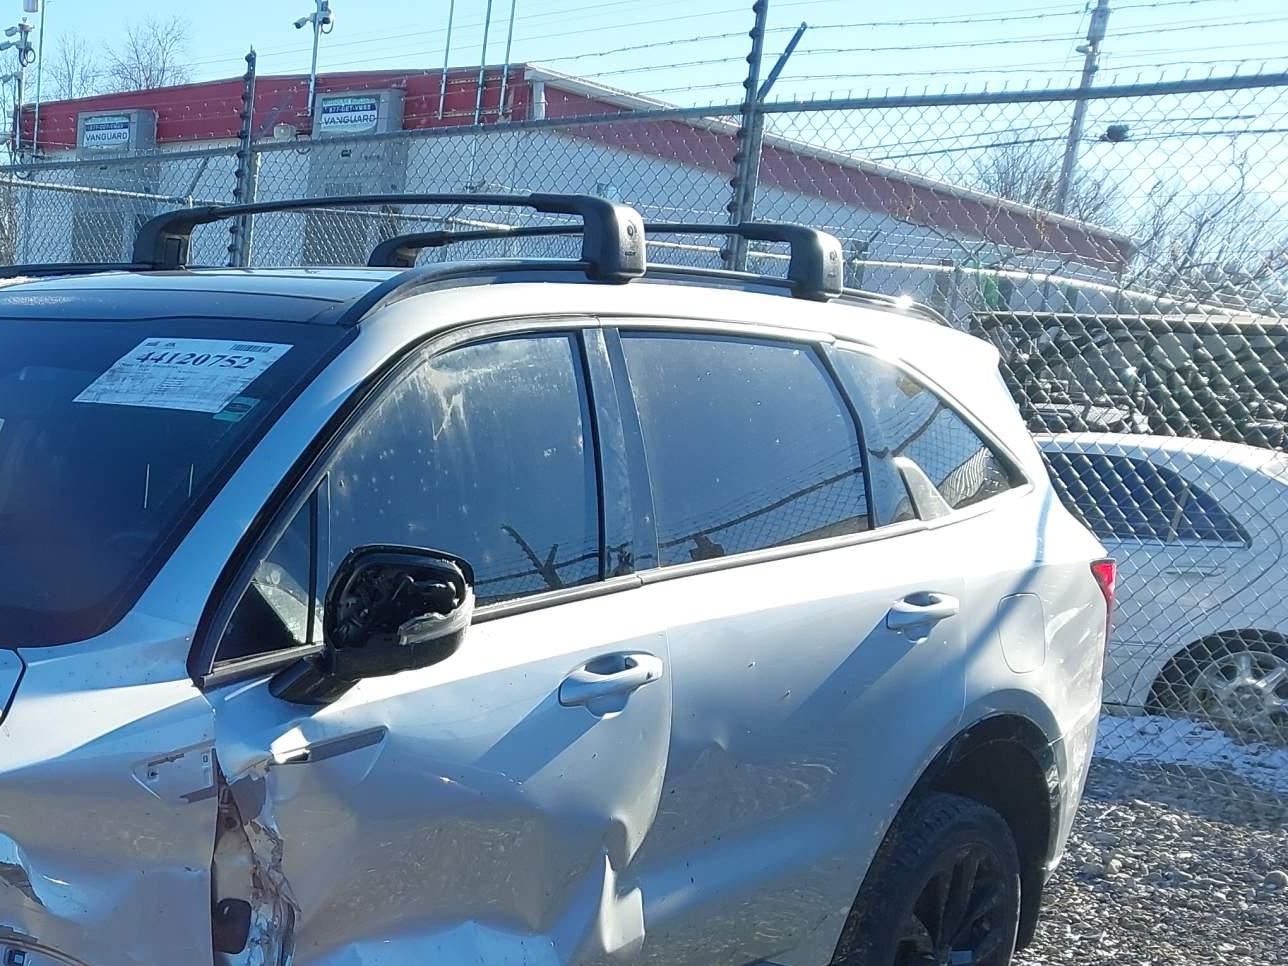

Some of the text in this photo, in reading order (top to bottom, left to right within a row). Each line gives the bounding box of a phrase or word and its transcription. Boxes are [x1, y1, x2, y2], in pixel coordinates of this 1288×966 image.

[324, 114, 376, 125] VANGUARD
[86, 132, 128, 142] VANGUARD
[136, 351, 255, 369] 44120752
